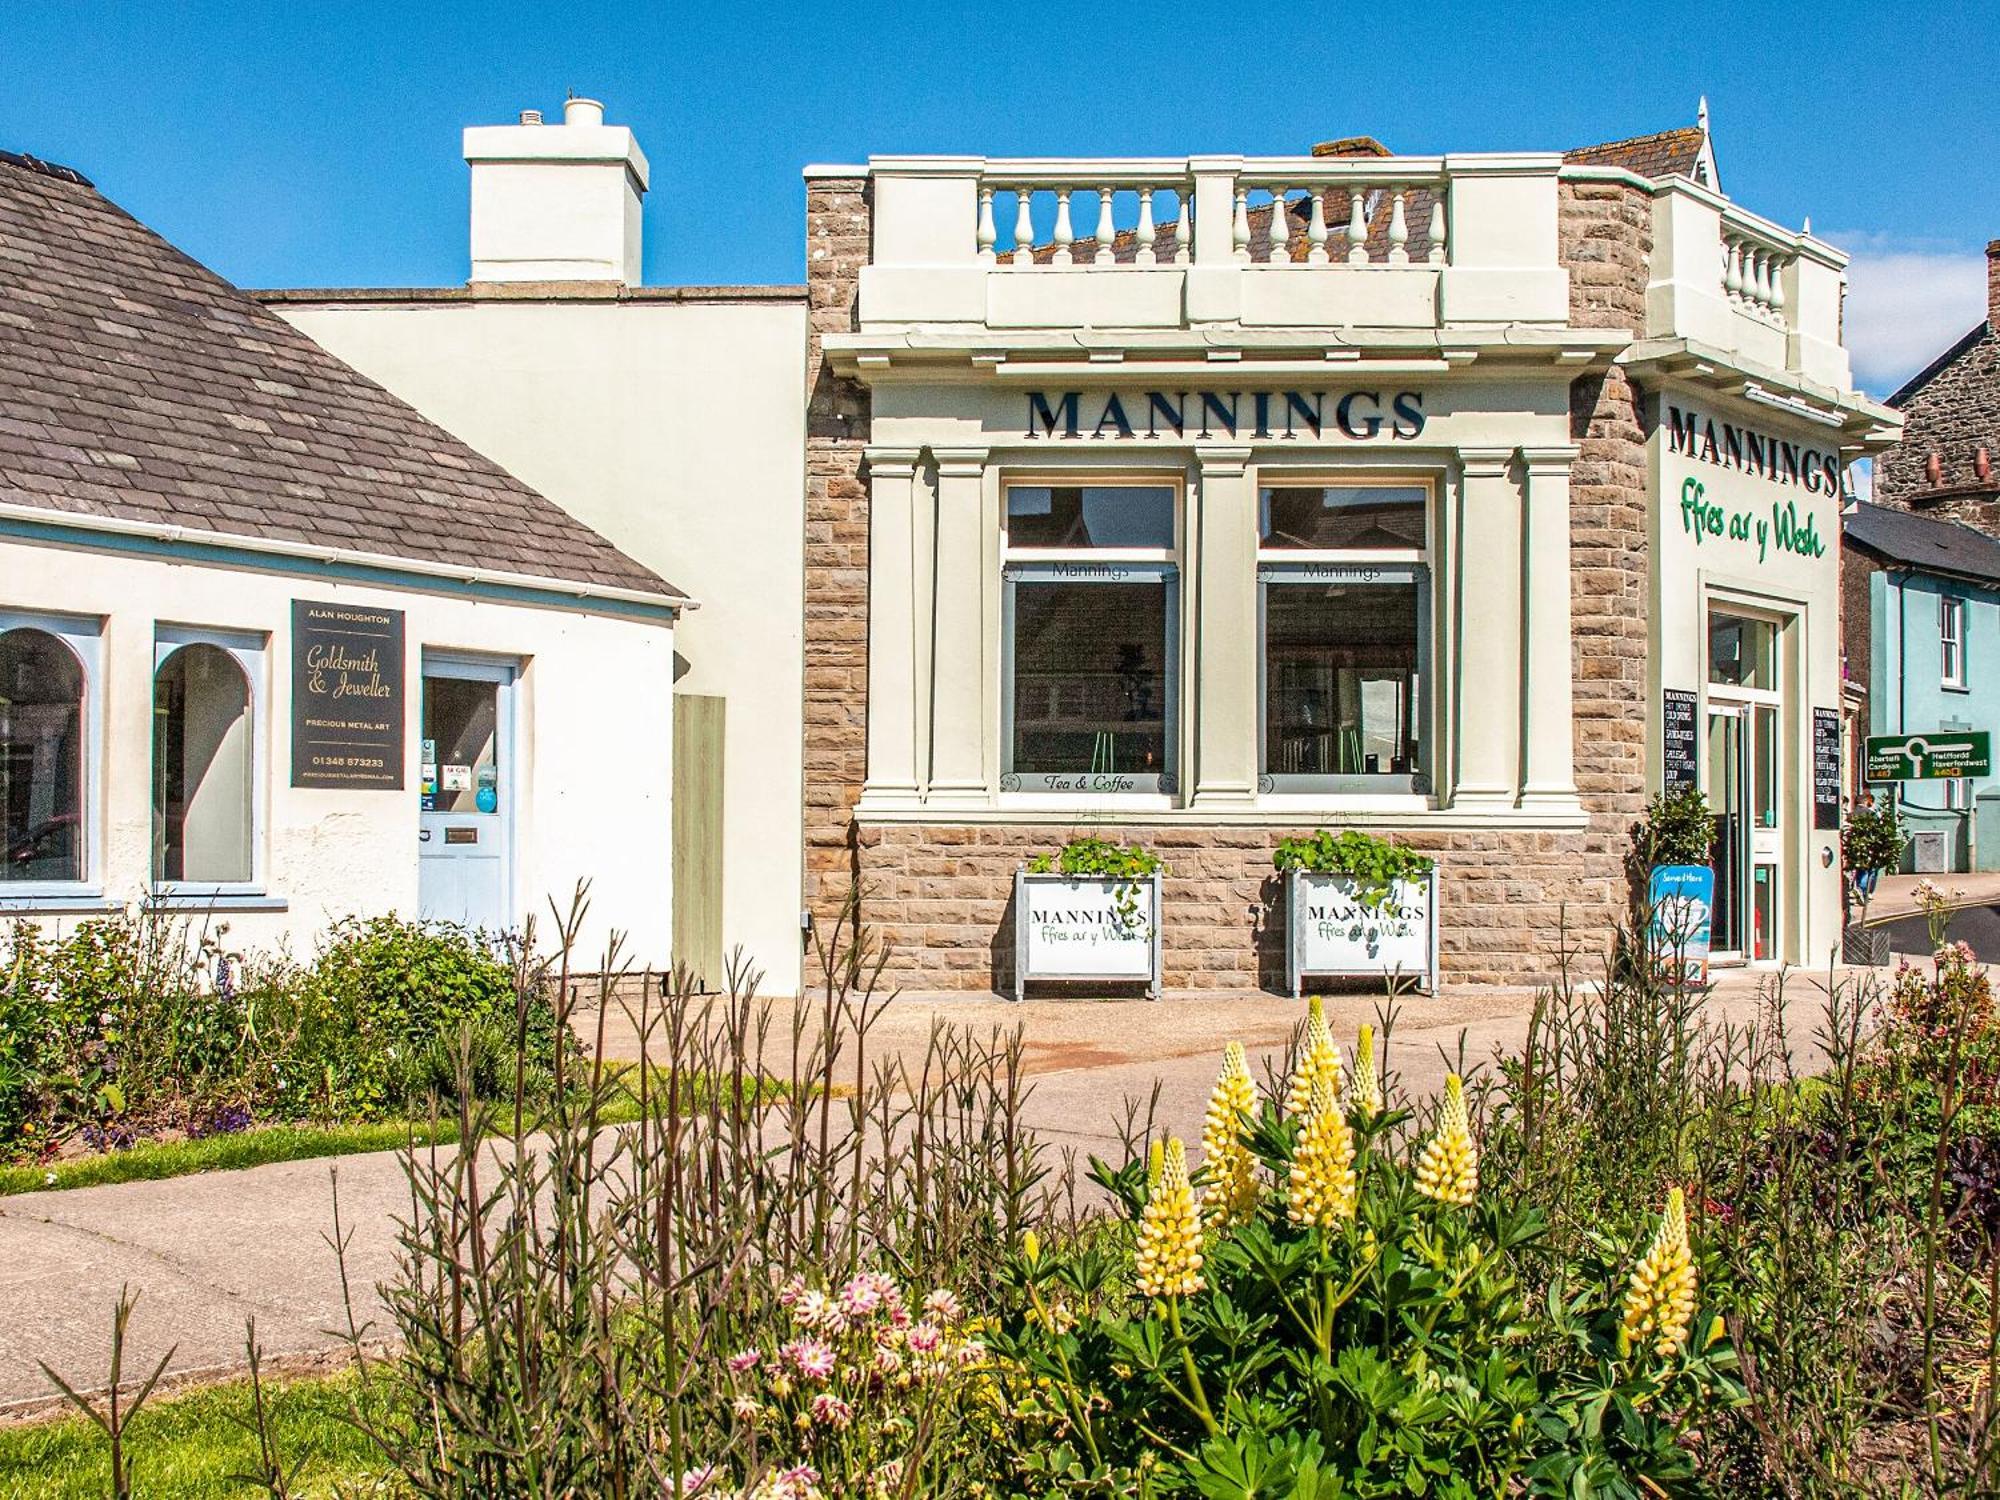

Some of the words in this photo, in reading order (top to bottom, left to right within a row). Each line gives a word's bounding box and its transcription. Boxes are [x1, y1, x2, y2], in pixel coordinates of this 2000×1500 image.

[1024, 391, 1426, 441] MANNINGS
[1668, 406, 1838, 498] MANNINGS
[1729, 511, 1753, 541] ar
[1756, 518, 1768, 564] y
[1052, 562, 1129, 581] Mannings
[1303, 562, 1381, 582] Mannings
[308, 609, 335, 619] ALAN
[336, 612, 390, 625] HOUGHTON
[307, 644, 379, 674] Goldsmith
[307, 671, 328, 693] &
[332, 671, 391, 699] Jeweller
[306, 719, 346, 729] PRECIOUS
[347, 722, 373, 730] METAL
[374, 723, 390, 731] ART
[1932, 751, 1970, 760] Hwlffordd
[1932, 759, 1987, 768] Haverfordwest
[1868, 763, 1900, 771] Cardigan
[1044, 775, 1069, 790] Tea
[1075, 776, 1087, 790] &
[1093, 775, 1134, 792] Coffee
[1072, 931, 1087, 941] ar
[1091, 931, 1098, 946] y
